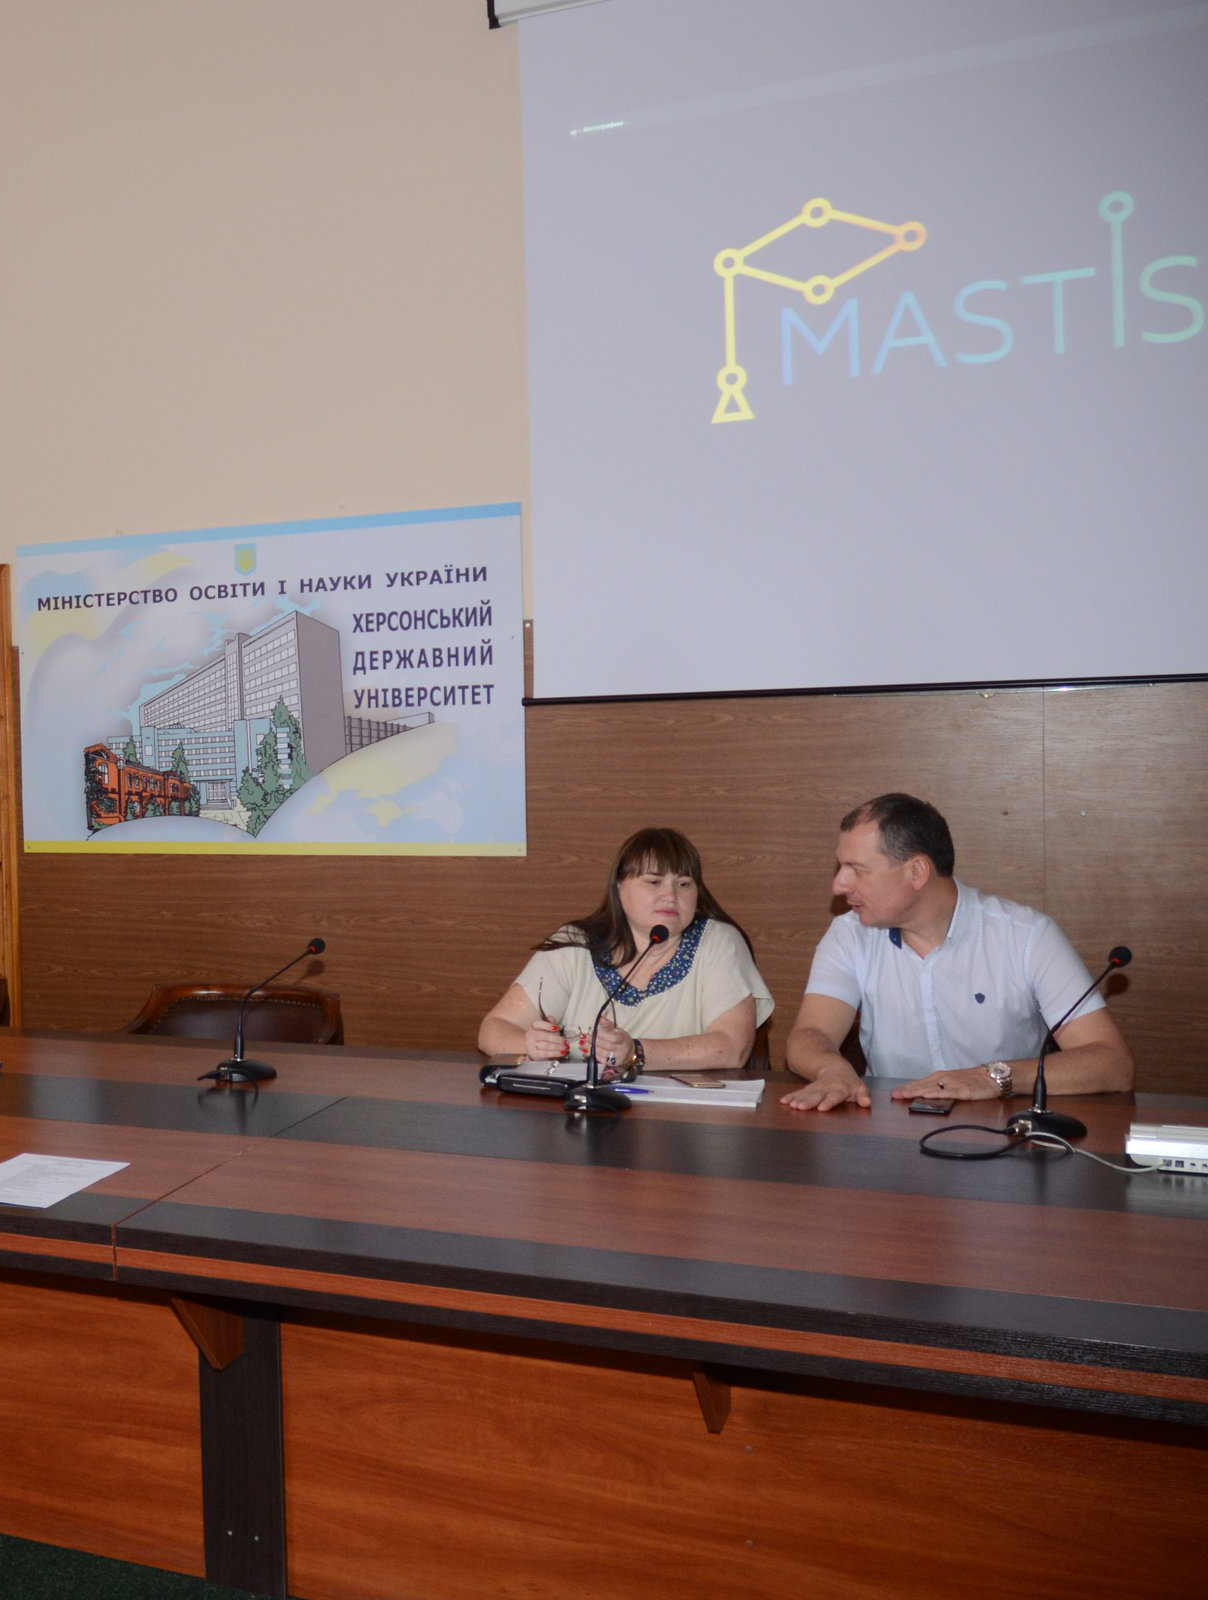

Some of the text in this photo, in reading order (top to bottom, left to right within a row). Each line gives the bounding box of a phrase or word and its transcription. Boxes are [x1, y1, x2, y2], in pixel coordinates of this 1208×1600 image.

[780, 191, 1206, 386] MASTIS
[37, 564, 488, 612] МІНІСТЕРСТВО ОСВІТИ І НАУКИ УКРАЇНИ
[352, 599, 493, 633] ХЕРСОНСЬКИЙ
[352, 638, 494, 675] ДЕРЖАВНИЙ
[353, 684, 495, 709] УНІВЕРСИТЕТ
